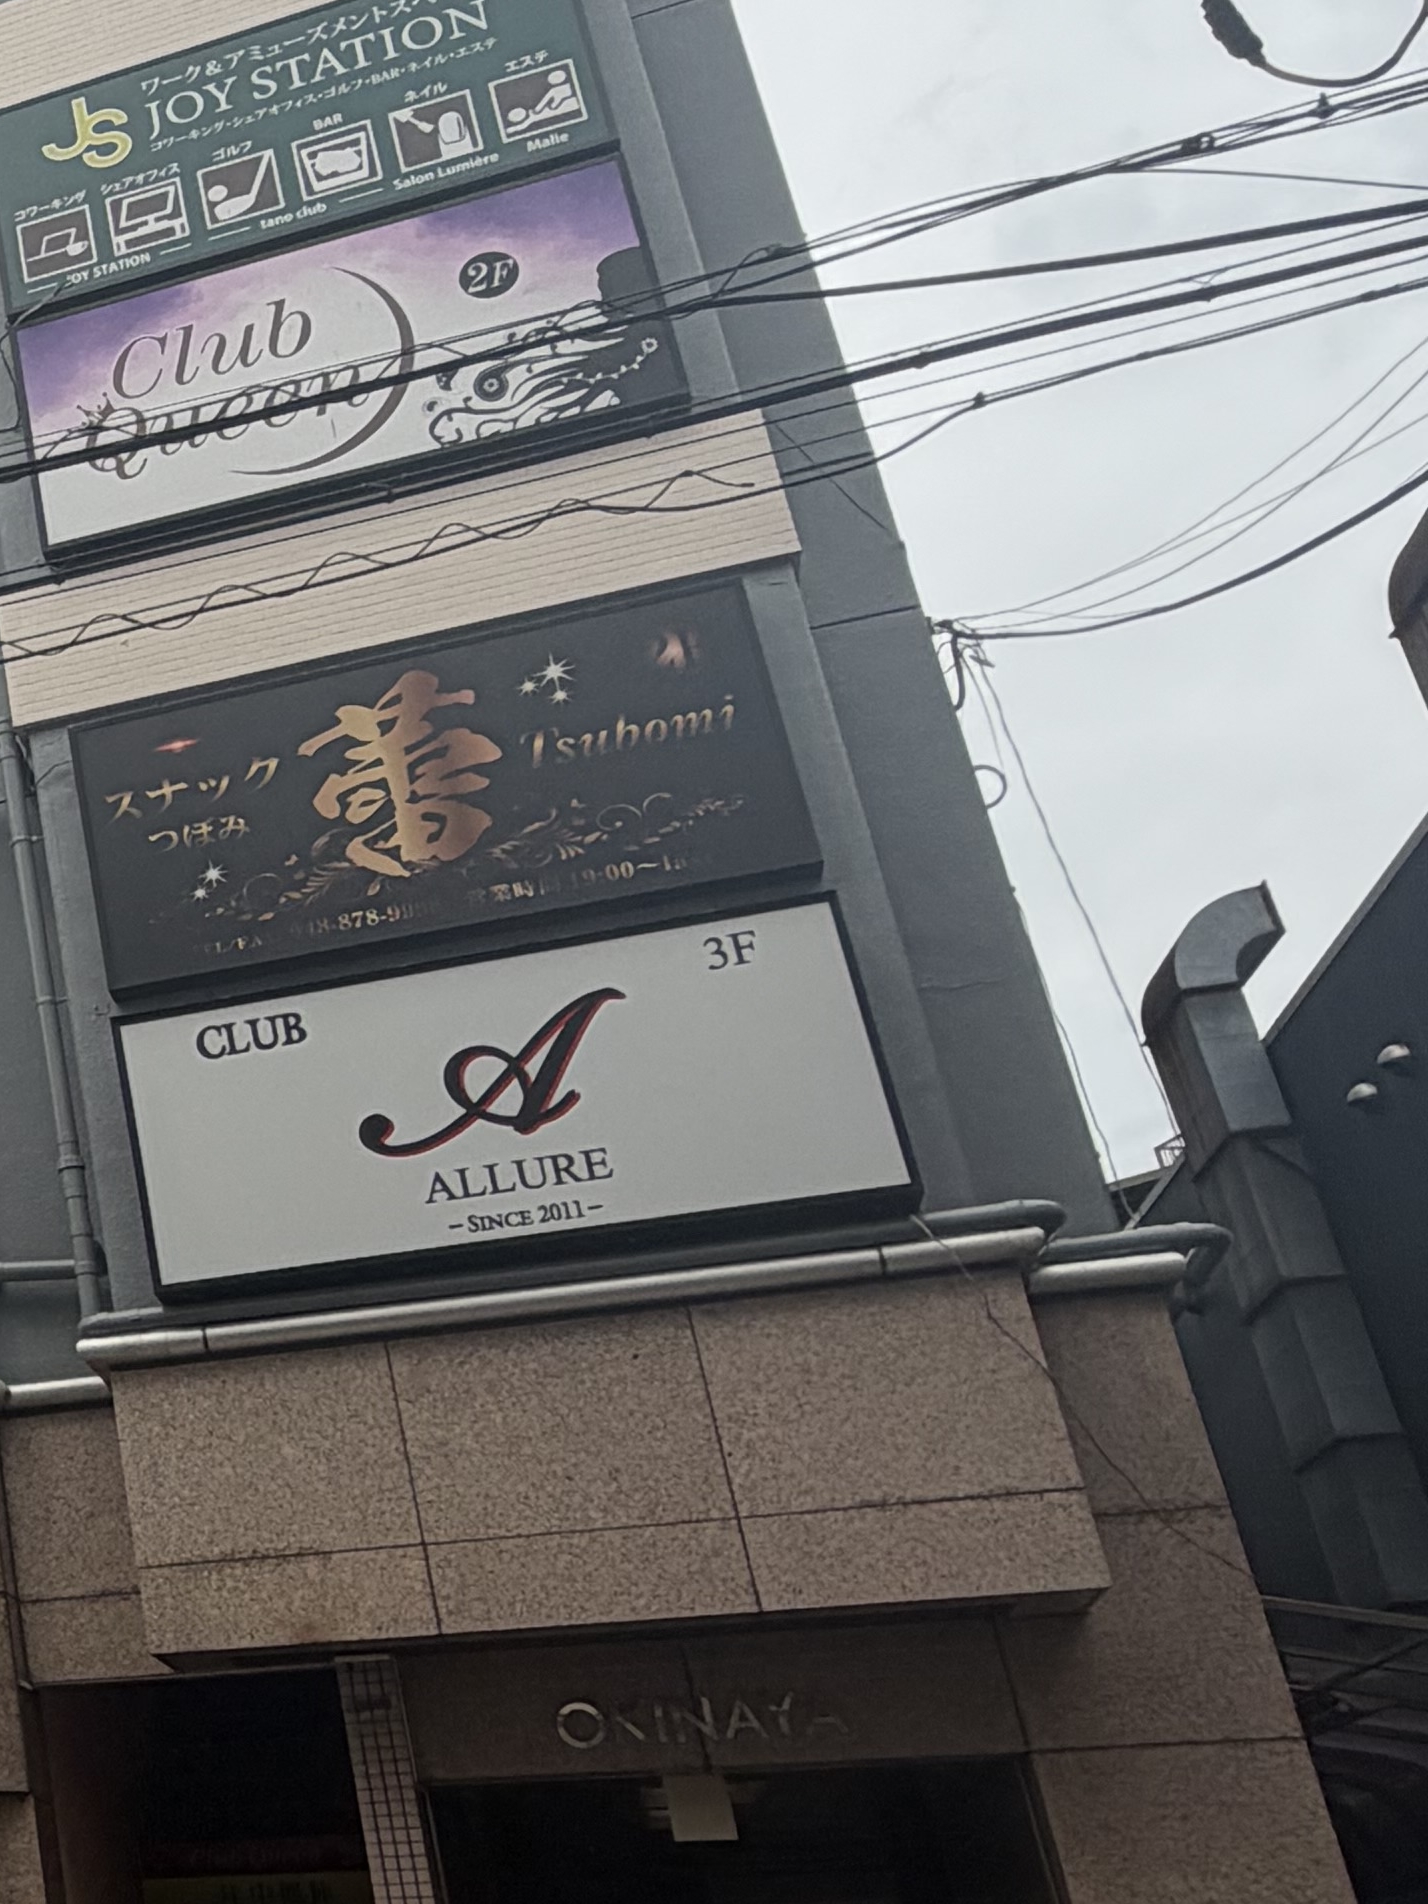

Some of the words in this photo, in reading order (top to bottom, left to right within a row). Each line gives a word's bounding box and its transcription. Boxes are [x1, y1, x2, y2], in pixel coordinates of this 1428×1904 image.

[505, 49, 548, 72] エステ
[144, 76, 237, 141] JOY
[404, 81, 448, 103] ネイル
[312, 112, 343, 131] BAR
[212, 140, 252, 163] ゴルフ
[100, 162, 181, 195] シェアオフィス
[393, 170, 435, 191] Salon
[13, 189, 86, 221] コワーキング
[296, 201, 327, 222] club
[93, 252, 151, 279] STATION
[466, 257, 515, 293] 2F
[112, 298, 313, 400] Club
[86, 362, 373, 480] Queen
[520, 694, 735, 769] Tsubomi
[105, 757, 281, 823] スナック
[147, 814, 249, 853] つぼみ
[702, 930, 757, 972] 3F
[195, 1011, 308, 1061] CLUB
[423, 1147, 615, 1205] ALLURE
